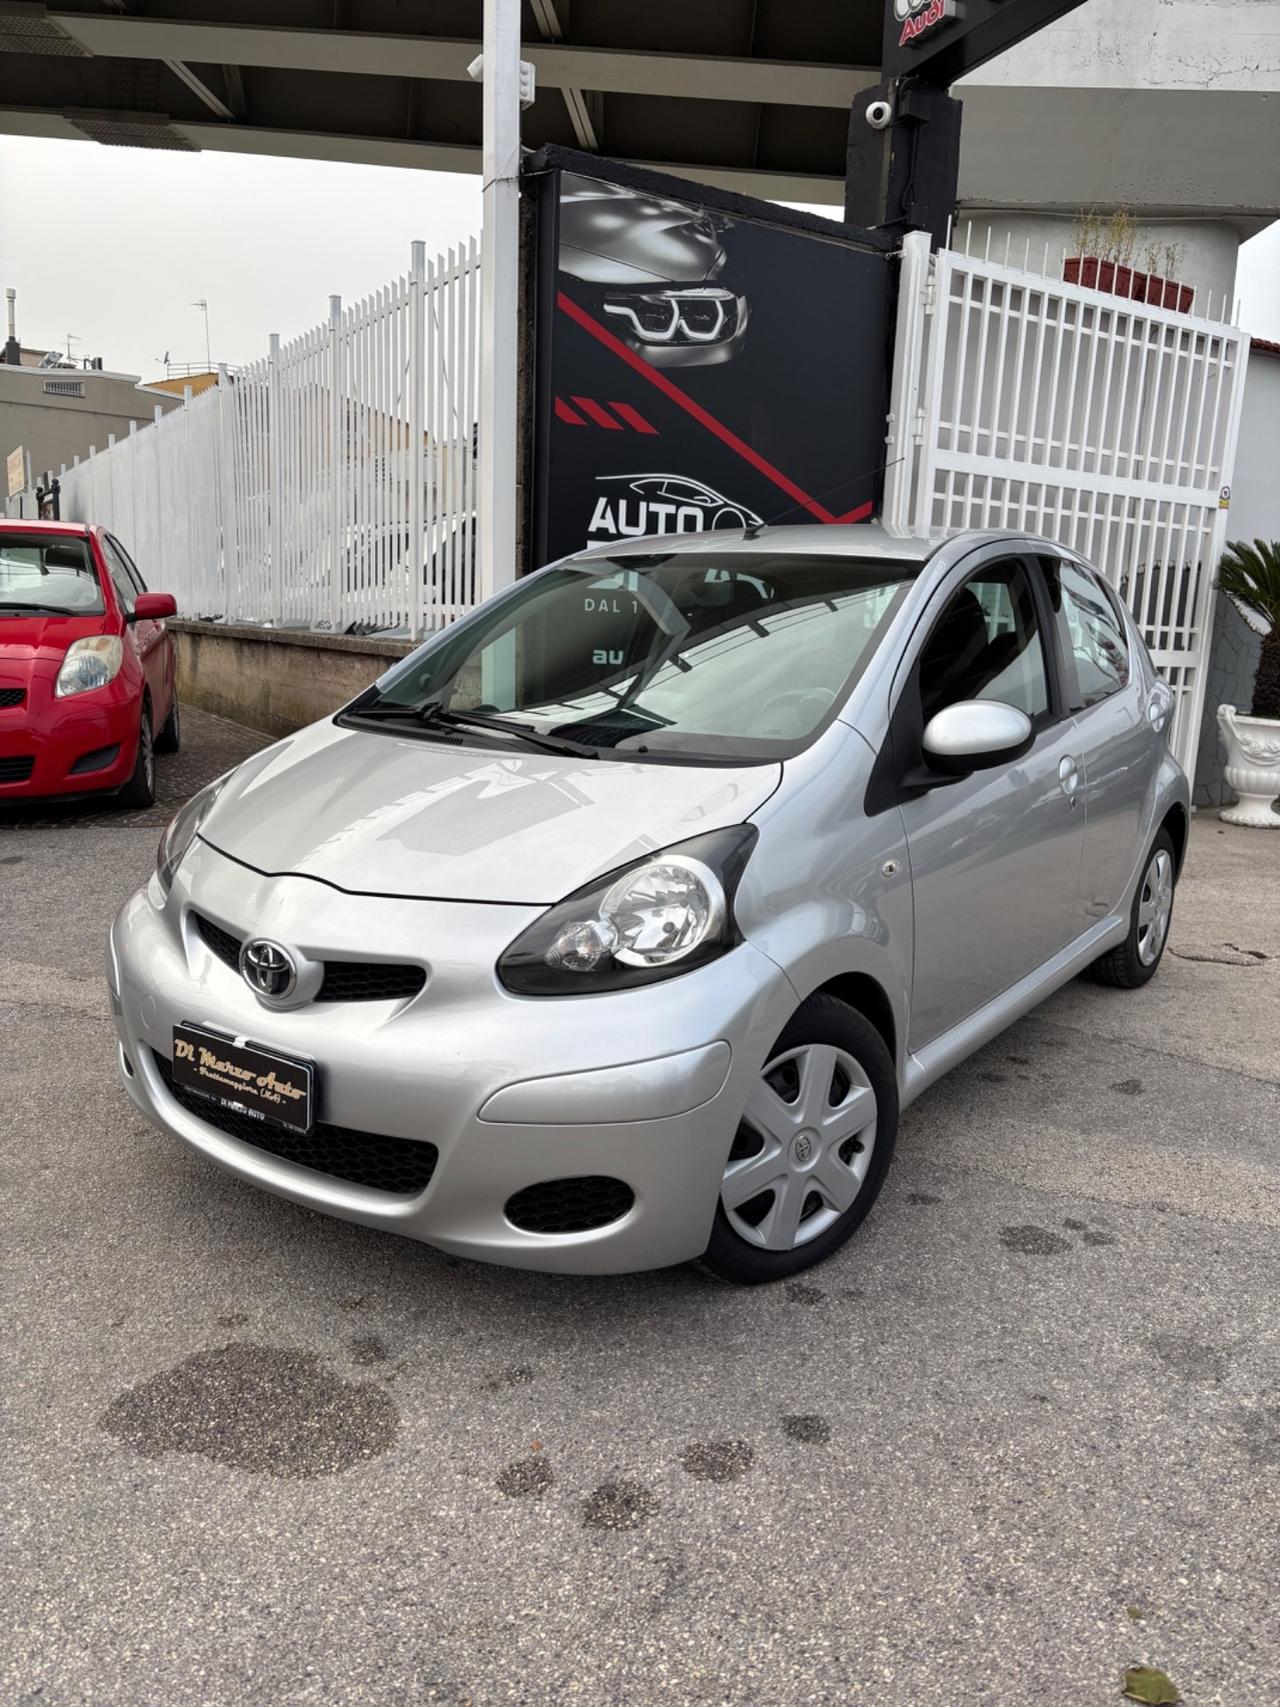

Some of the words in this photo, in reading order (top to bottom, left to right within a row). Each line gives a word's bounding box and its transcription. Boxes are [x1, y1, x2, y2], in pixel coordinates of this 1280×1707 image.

[588, 497, 704, 536] AUTO
[584, 598, 620, 612] DAL
[198, 1046, 257, 1081] Marzo
[256, 1071, 307, 1100] Auto
[248, 1108, 265, 1121] AUTO
